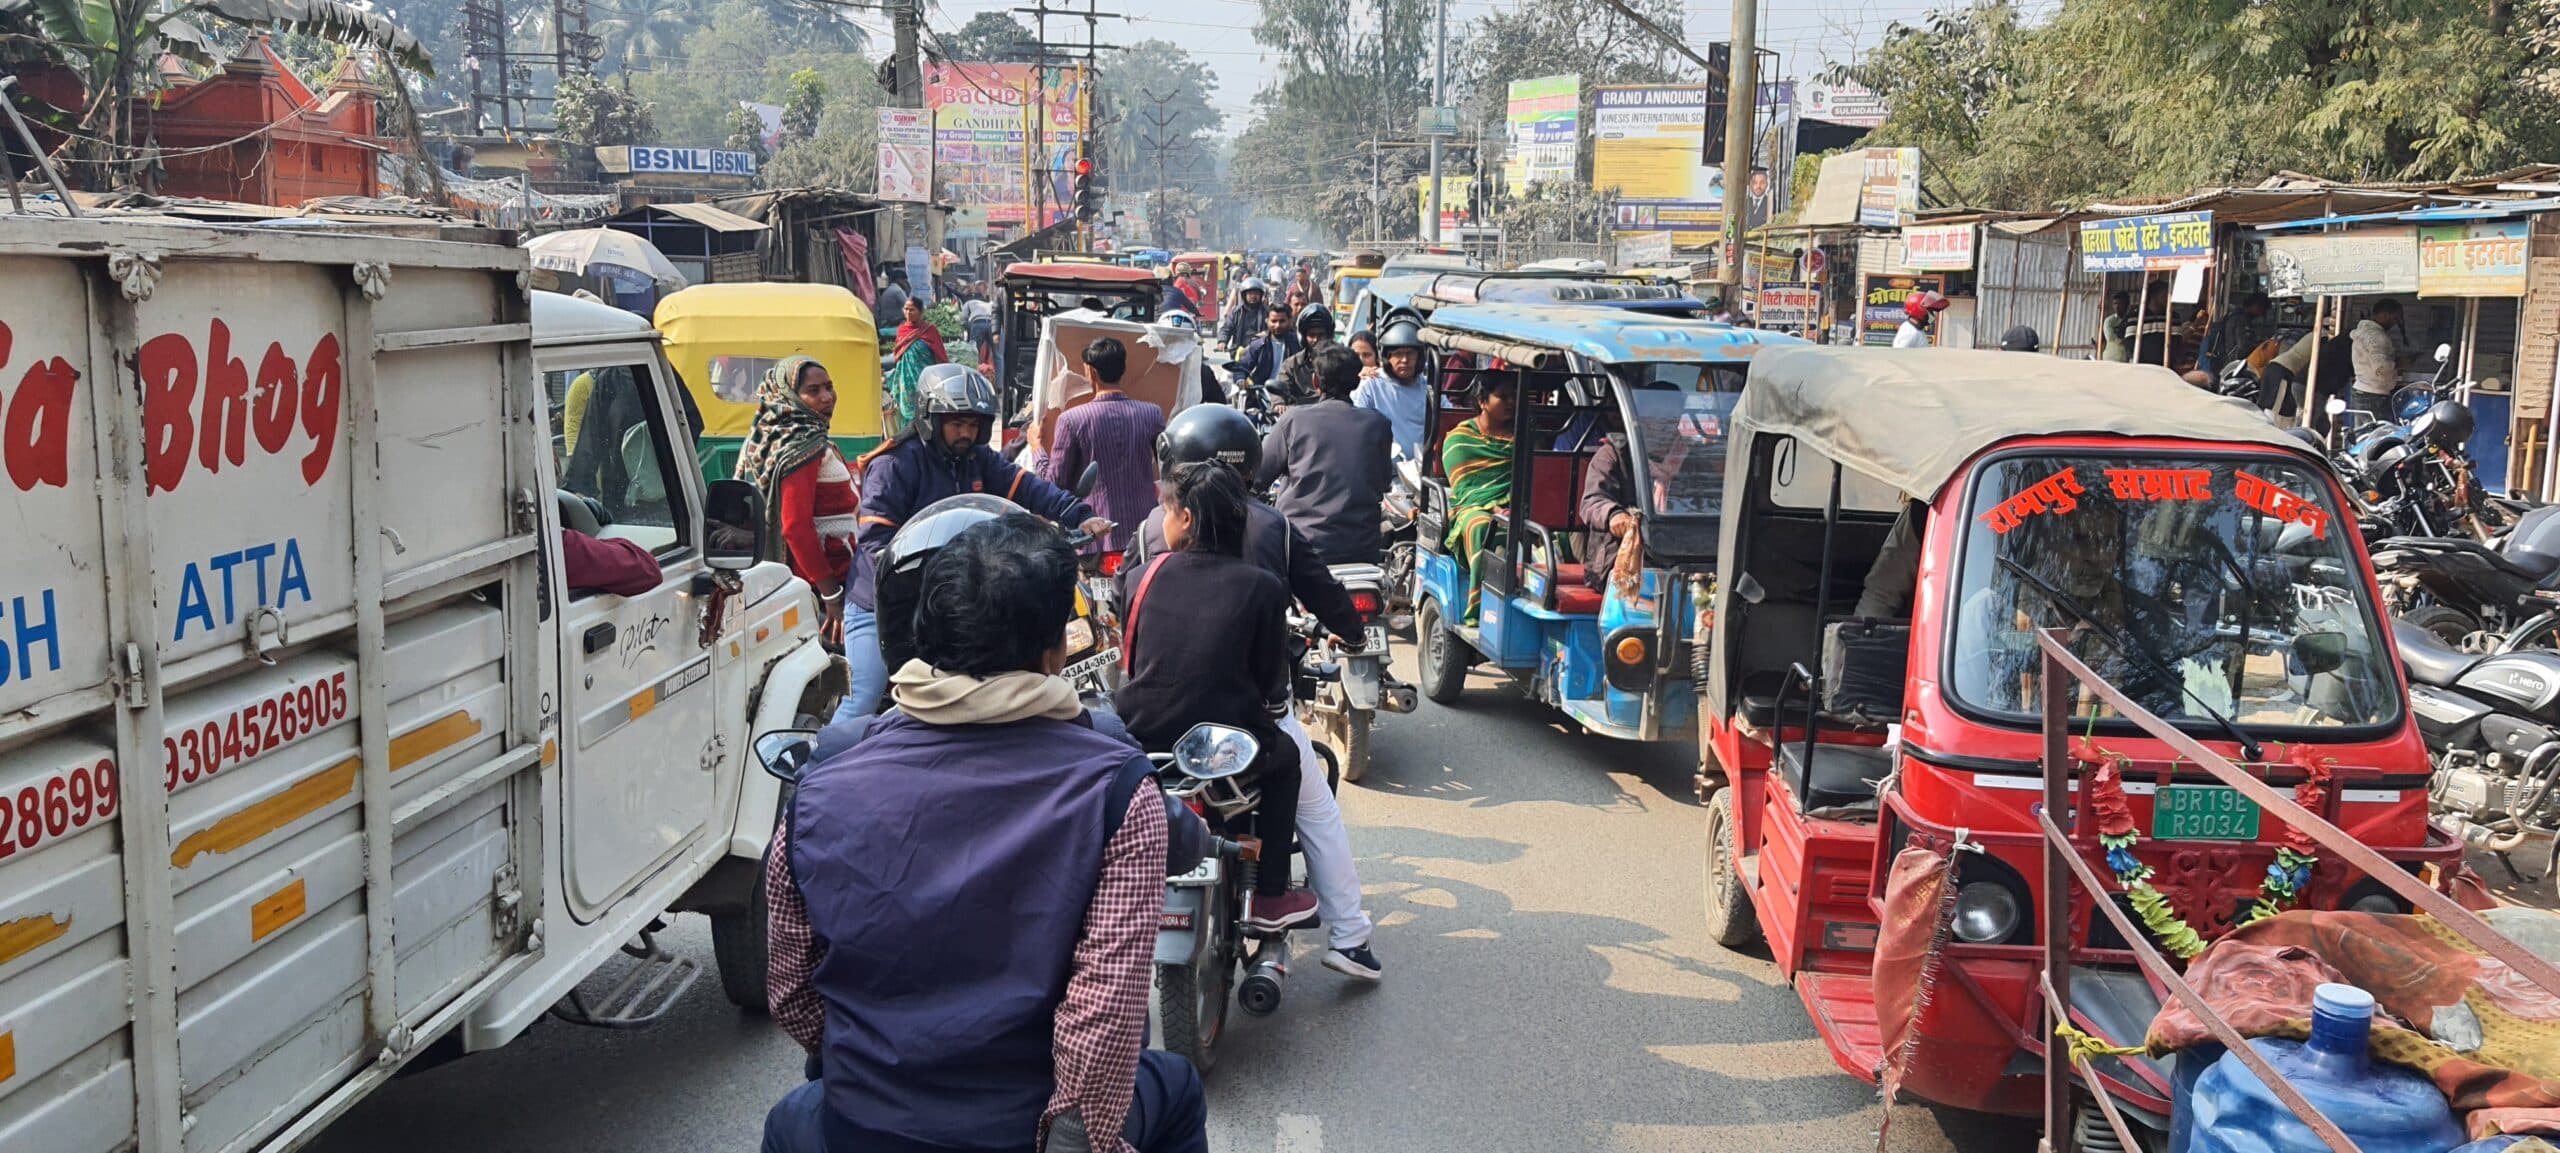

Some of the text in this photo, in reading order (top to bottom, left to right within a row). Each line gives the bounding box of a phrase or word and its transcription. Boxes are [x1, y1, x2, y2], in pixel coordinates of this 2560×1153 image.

[1602, 91, 1642, 105] GRAND
[953, 117, 1004, 129] GANDHI
[1055, 114, 1072, 122] AC
[1601, 112, 1630, 123] KINESIS
[1631, 112, 1689, 123] INTERNATIONAL
[949, 130, 971, 141] Group
[975, 132, 1005, 141] Nursery
[1056, 132, 1070, 141] Day
[634, 148, 707, 170] BSNL
[715, 151, 754, 173] BSNL
[2422, 236, 2458, 267] रीना
[1763, 290, 1781, 305] सिटी
[139, 317, 341, 497] Bhog
[1976, 466, 2332, 541] रामपुर सम्राट वाहन
[173, 537, 312, 642] ATTA
[620, 612, 670, 669] Pilot
[664, 660, 709, 697] POWER STEERING
[163, 671, 347, 792] 9304526905
[2173, 814, 2247, 836] R3034
